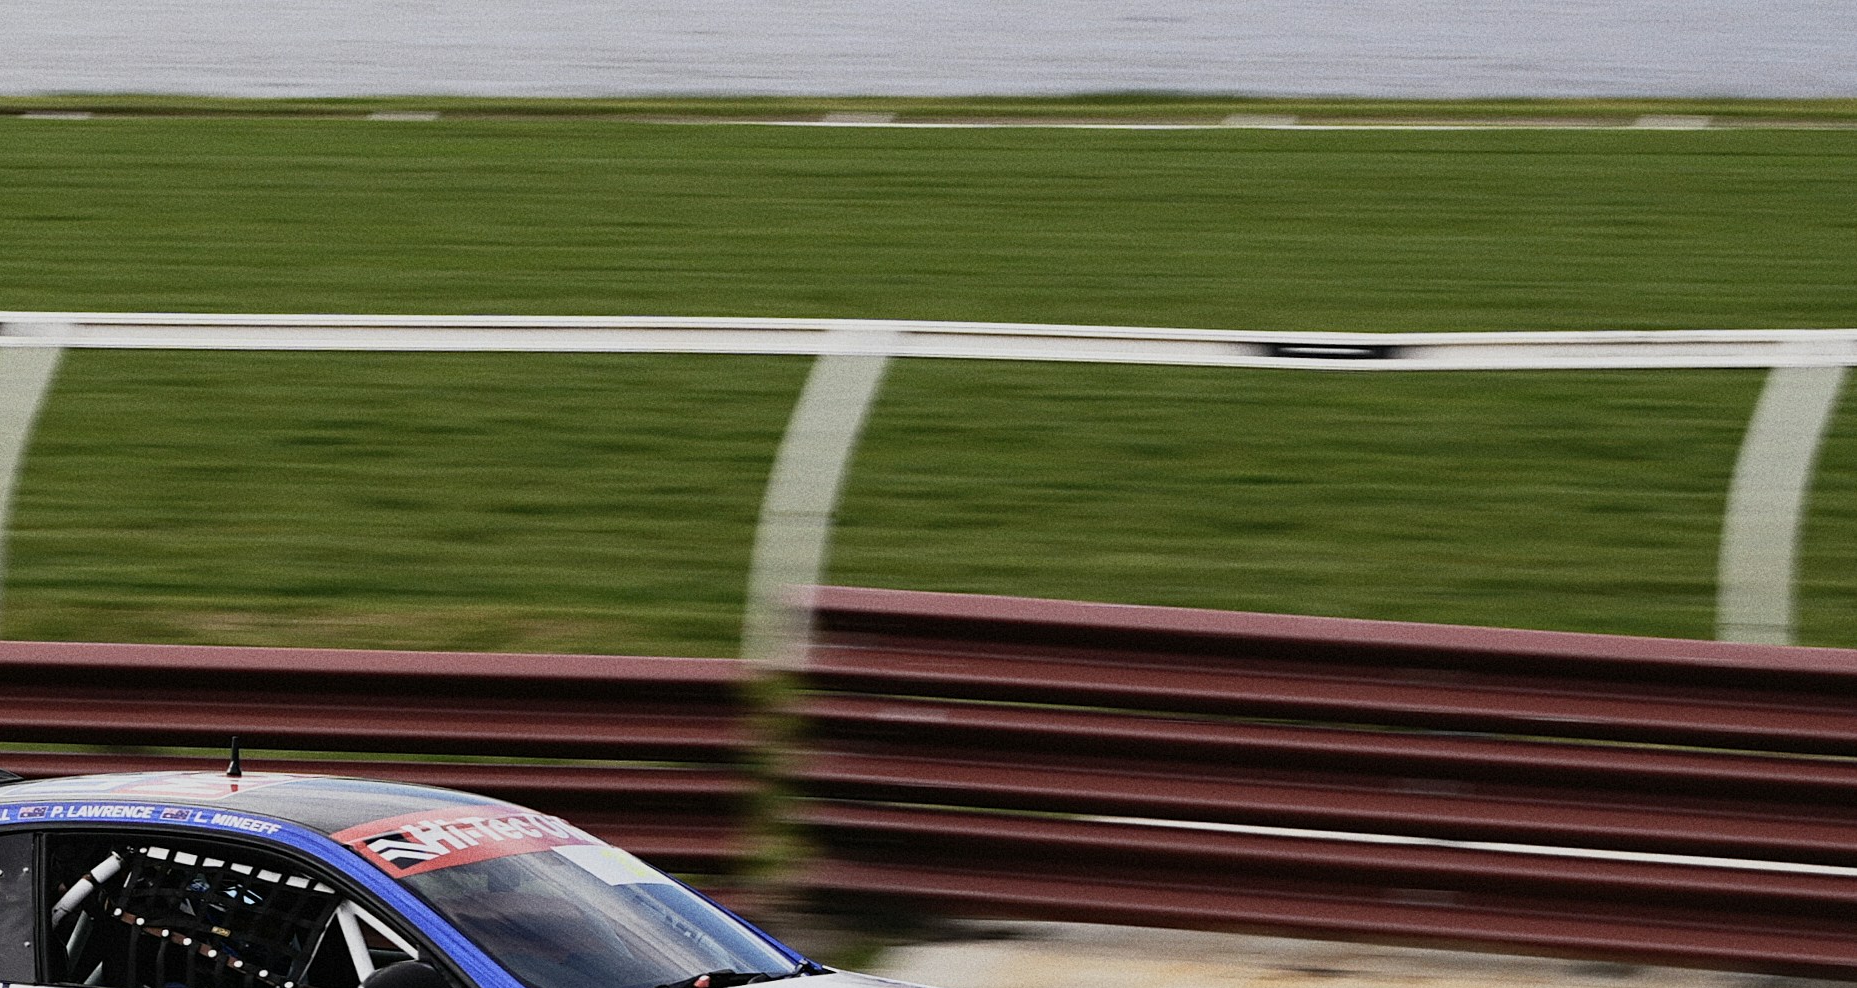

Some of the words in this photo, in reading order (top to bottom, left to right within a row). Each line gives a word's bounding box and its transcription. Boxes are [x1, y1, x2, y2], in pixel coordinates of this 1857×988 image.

[50, 805, 65, 818] P.
[67, 805, 155, 819] LAWRENCE
[211, 813, 282, 835] MINEEFF
